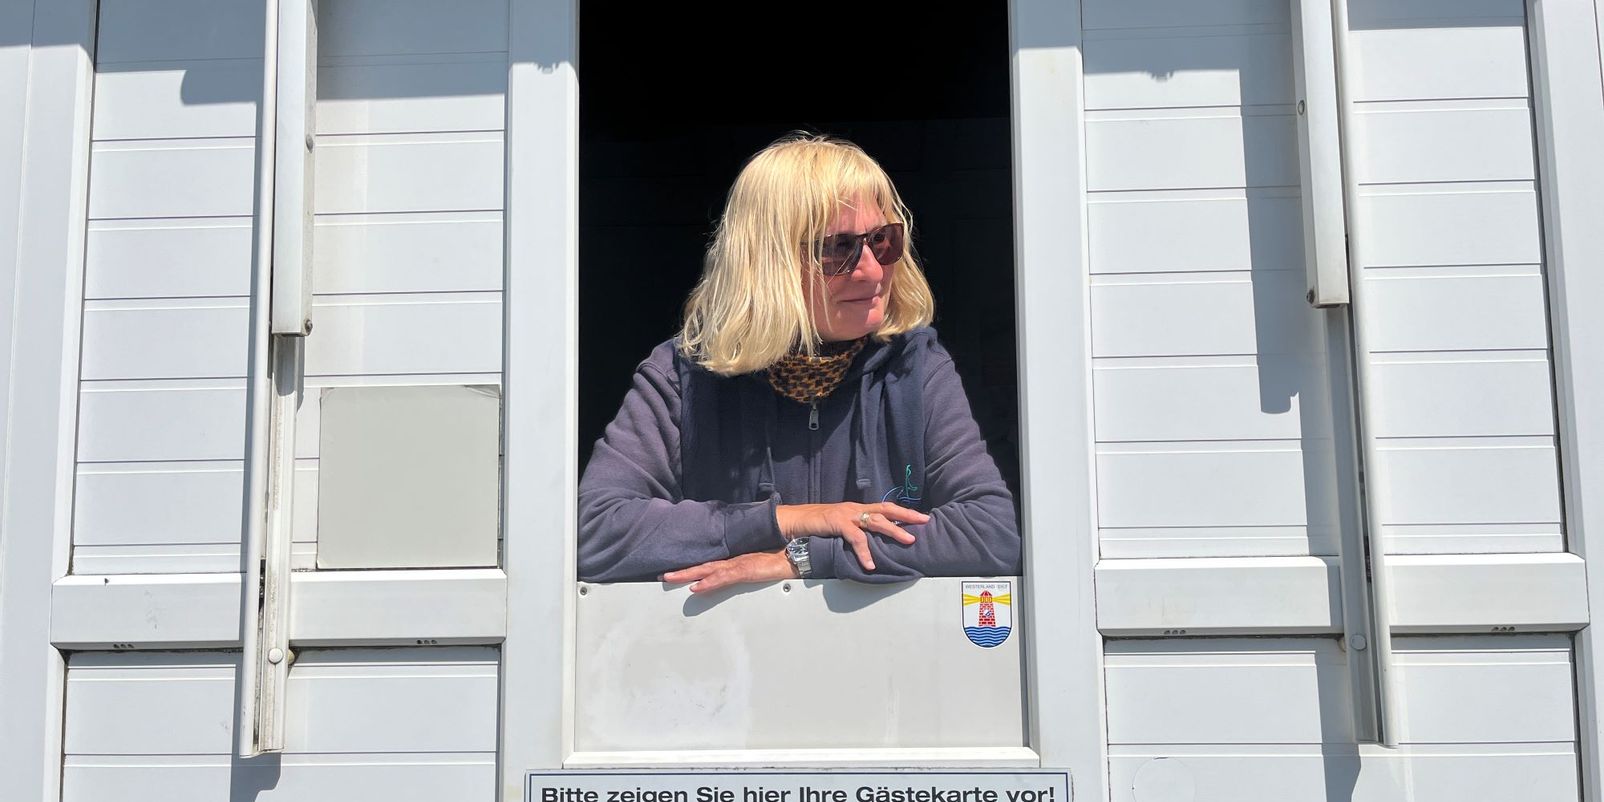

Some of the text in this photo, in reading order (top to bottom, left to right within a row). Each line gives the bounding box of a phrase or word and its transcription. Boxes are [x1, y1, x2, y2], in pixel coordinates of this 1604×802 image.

[541, 787, 599, 802] Bitte
[696, 787, 735, 802] Sie
[743, 786, 791, 802] hier
[799, 786, 848, 802] Ihre
[856, 786, 998, 802] Gästekarte
[1005, 786, 1055, 802] vor!
